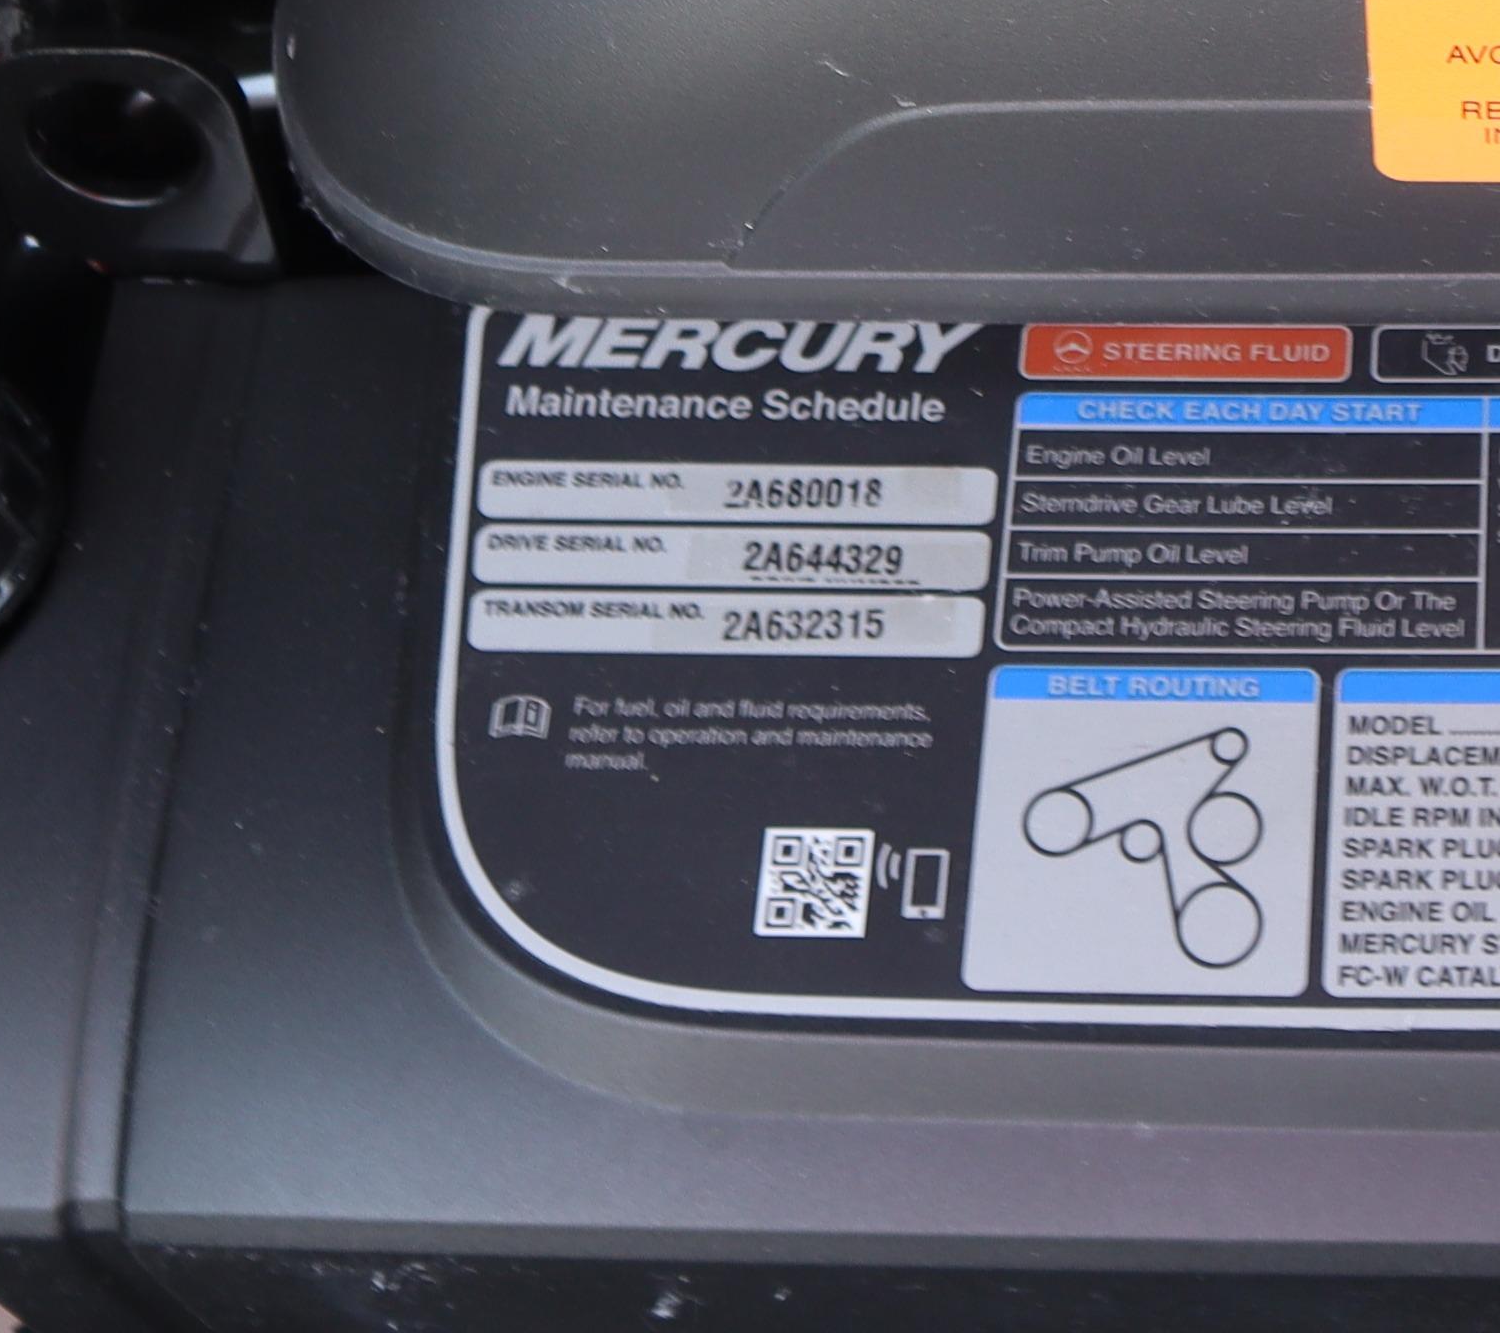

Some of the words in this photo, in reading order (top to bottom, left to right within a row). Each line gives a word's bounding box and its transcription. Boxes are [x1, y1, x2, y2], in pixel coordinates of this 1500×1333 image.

[498, 319, 984, 373] MERCURY
[1103, 341, 1242, 362] STEERING
[1249, 343, 1330, 362] FLUID
[505, 384, 752, 420] Maintenance
[762, 389, 946, 423] Schedule
[1077, 402, 1176, 421] CHECK
[1183, 403, 1261, 421] EACH
[1268, 403, 1324, 422] DAY
[1331, 403, 1421, 422] START
[1025, 446, 1105, 470] Engine
[1110, 446, 1143, 465] Oil
[1148, 447, 1211, 466] Level
[492, 469, 568, 488] ENGINE
[572, 471, 647, 489] SERIAL
[652, 472, 685, 490] NO.
[723, 478, 883, 510] 2A680018
[487, 534, 550, 551] DRIVE
[554, 535, 628, 553] SERIAL
[632, 536, 666, 554] NO.
[1018, 542, 1068, 563] Trim
[1073, 544, 1142, 567] Pump
[1147, 544, 1180, 564] Oil
[1186, 545, 1248, 565] Level
[743, 541, 904, 576] 2A644329
[484, 600, 587, 619] TRANSOM
[591, 601, 666, 620] SERIAL
[670, 603, 705, 621] NO.
[722, 609, 884, 642] 2A632315
[1048, 676, 1121, 695] BELT
[1128, 677, 1260, 699] ROUTING
[1348, 715, 1443, 735] MODEL
[1345, 776, 1412, 797] MAX.
[1418, 776, 1498, 797] W.O.T.
[1343, 807, 1405, 827] IDLE
[1412, 807, 1470, 828] RPM
[1343, 838, 1435, 859] SPARK
[1341, 870, 1434, 891] SPARK
[1340, 901, 1444, 922] ENGINE
[1451, 901, 1496, 923] OIL
[1339, 933, 1475, 955] MERCURY
[1338, 966, 1409, 988] FC-W
